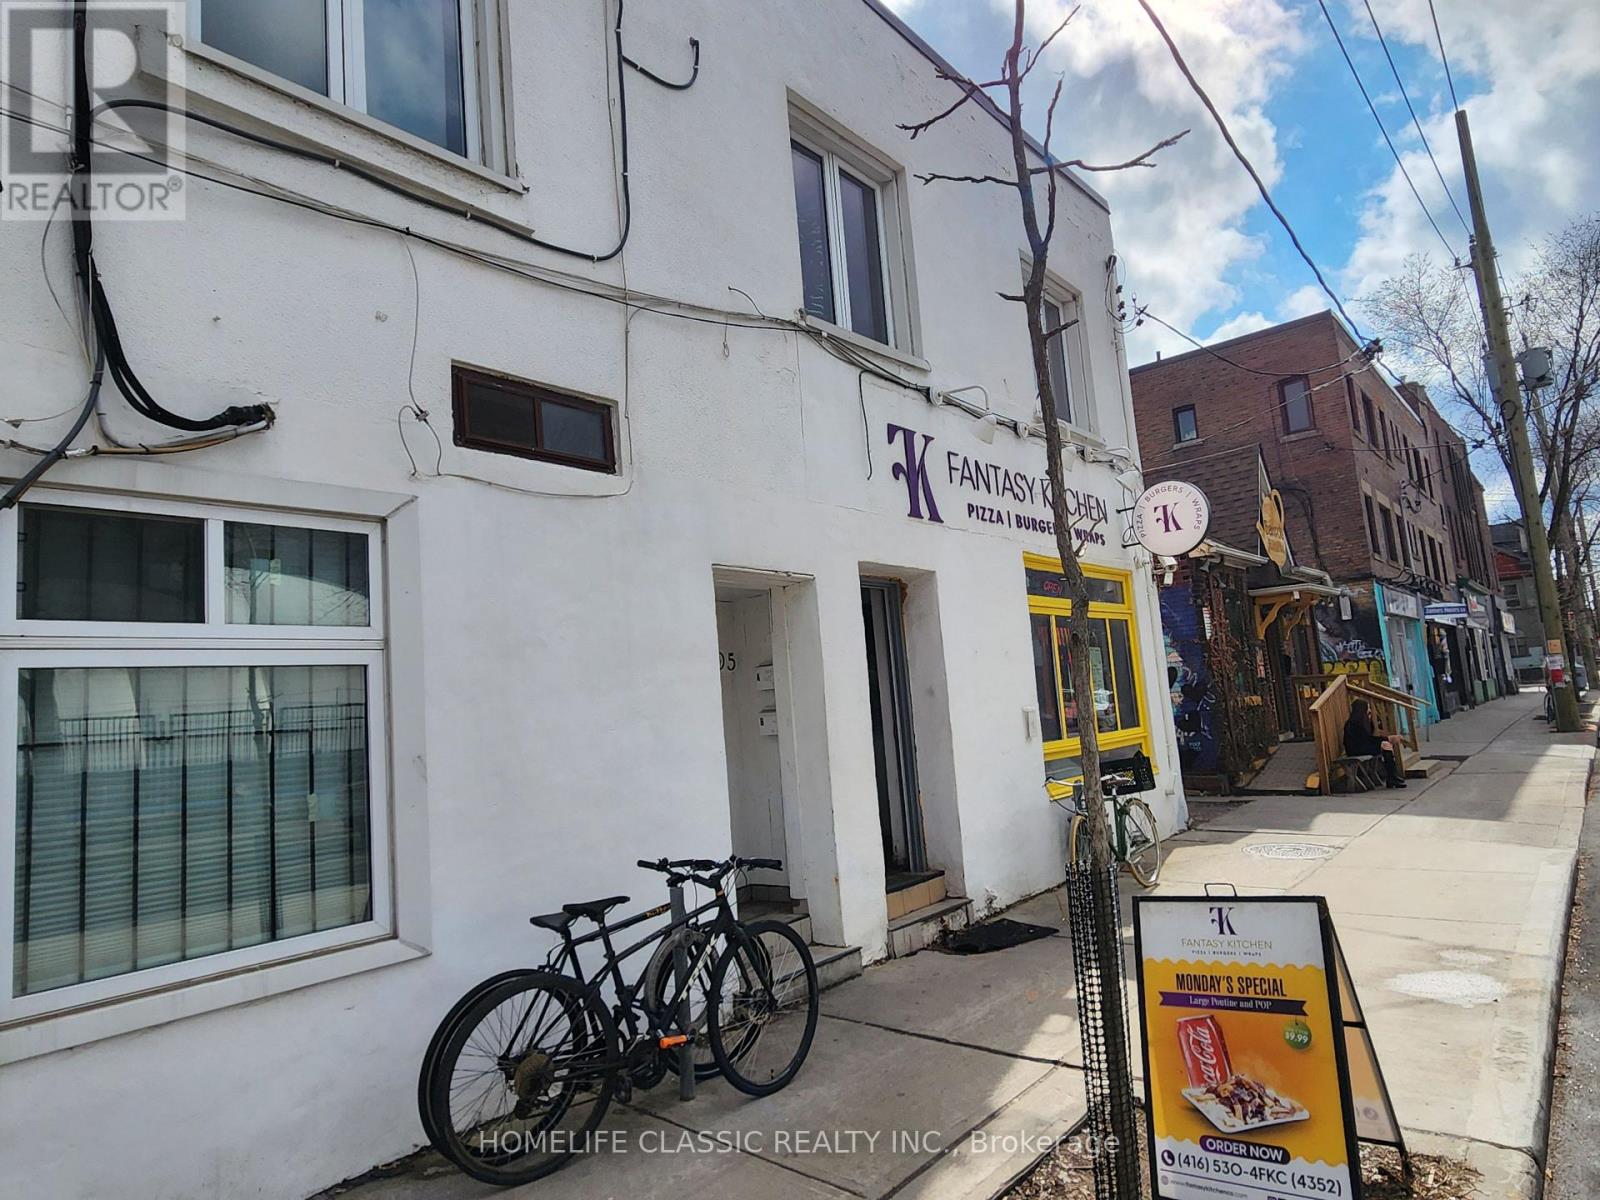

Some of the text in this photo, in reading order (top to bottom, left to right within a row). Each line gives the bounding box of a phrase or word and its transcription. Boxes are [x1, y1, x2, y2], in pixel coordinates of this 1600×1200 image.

[947, 450, 1109, 525] FANTASY KCHEN
[967, 502, 1005, 526] PIZZA
[1015, 513, 1057, 536] BURGE
[1136, 513, 1147, 538] PIZZA
[1144, 485, 1184, 503] BURGERS
[1192, 498, 1203, 530] WRAPS
[1181, 938, 1273, 950] FANTASY KITCHEN
[1176, 973, 1287, 997] MONDAY'S SPECIAL
[1189, 995, 1210, 1007] Large
[1239, 1000, 1253, 1009] and
[1254, 1000, 1272, 1010] POP
[1206, 1138, 1283, 1161] ORDER NOW
[1178, 1152, 1342, 1197] (416) 530-4FKC (4352)
